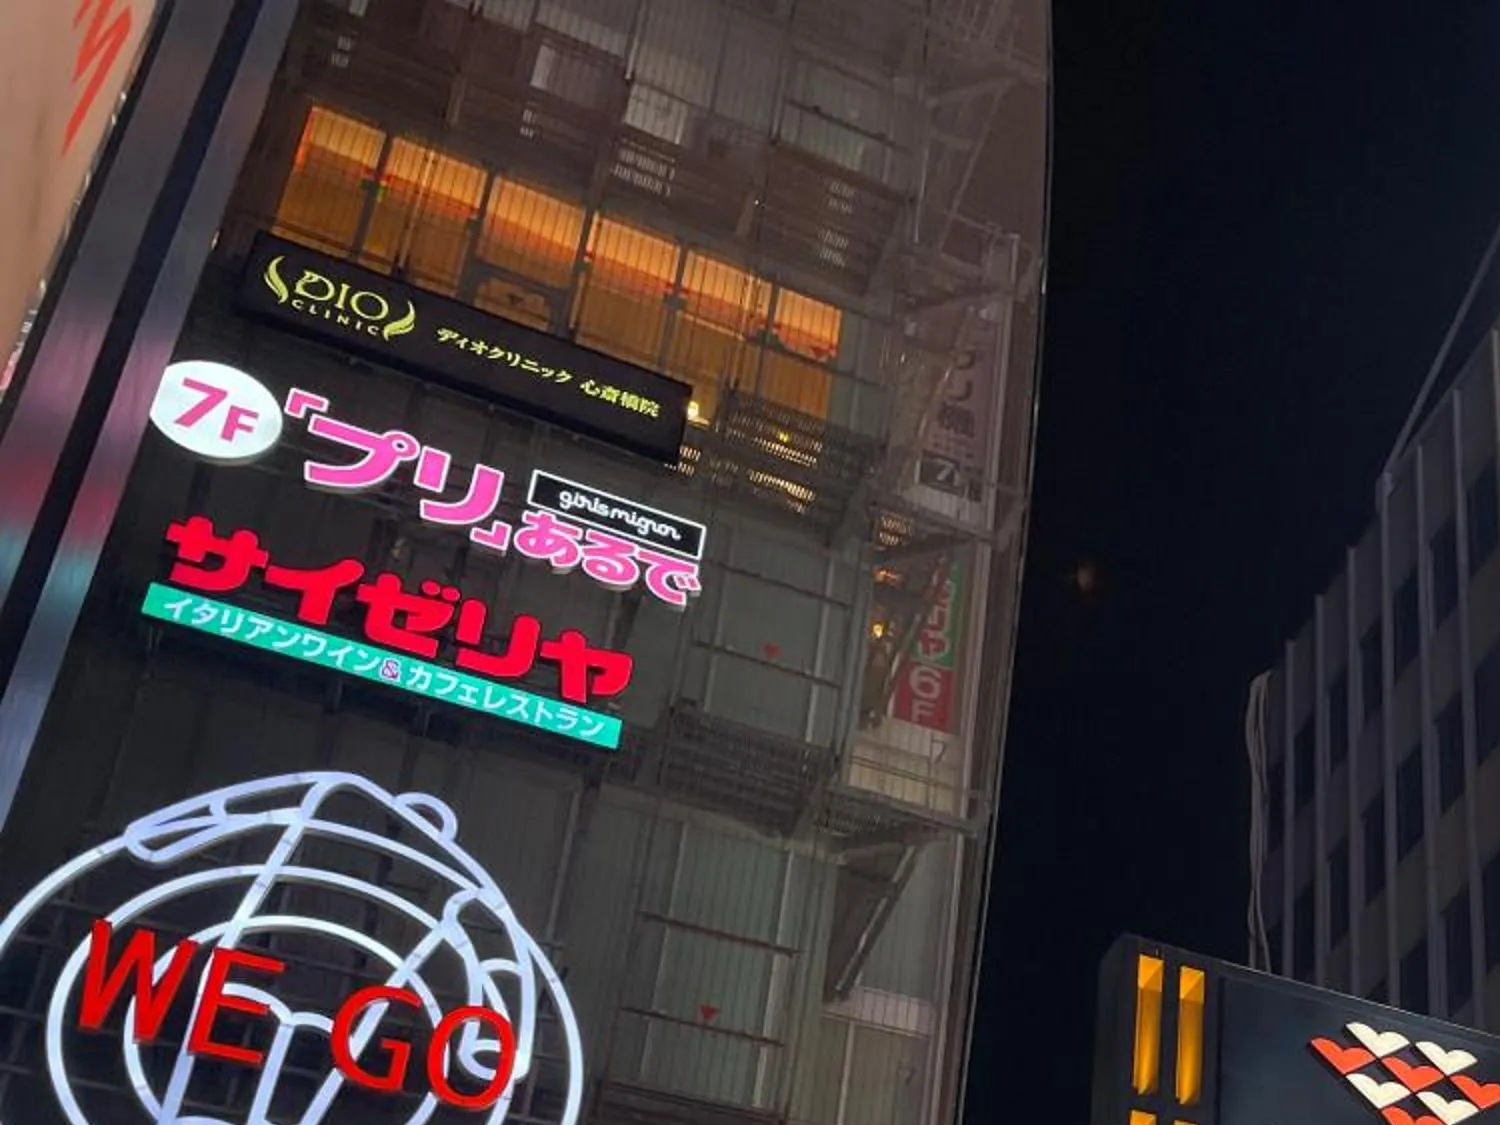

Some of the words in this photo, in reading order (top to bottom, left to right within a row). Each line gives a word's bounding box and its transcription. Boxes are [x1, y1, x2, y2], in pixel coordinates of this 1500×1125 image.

[291, 299, 382, 337] CLINIC
[294, 269, 392, 325] DIO
[435, 326, 574, 385] ディオクリニック
[175, 377, 260, 441] 7F
[163, 514, 634, 704] サイゼリヤ
